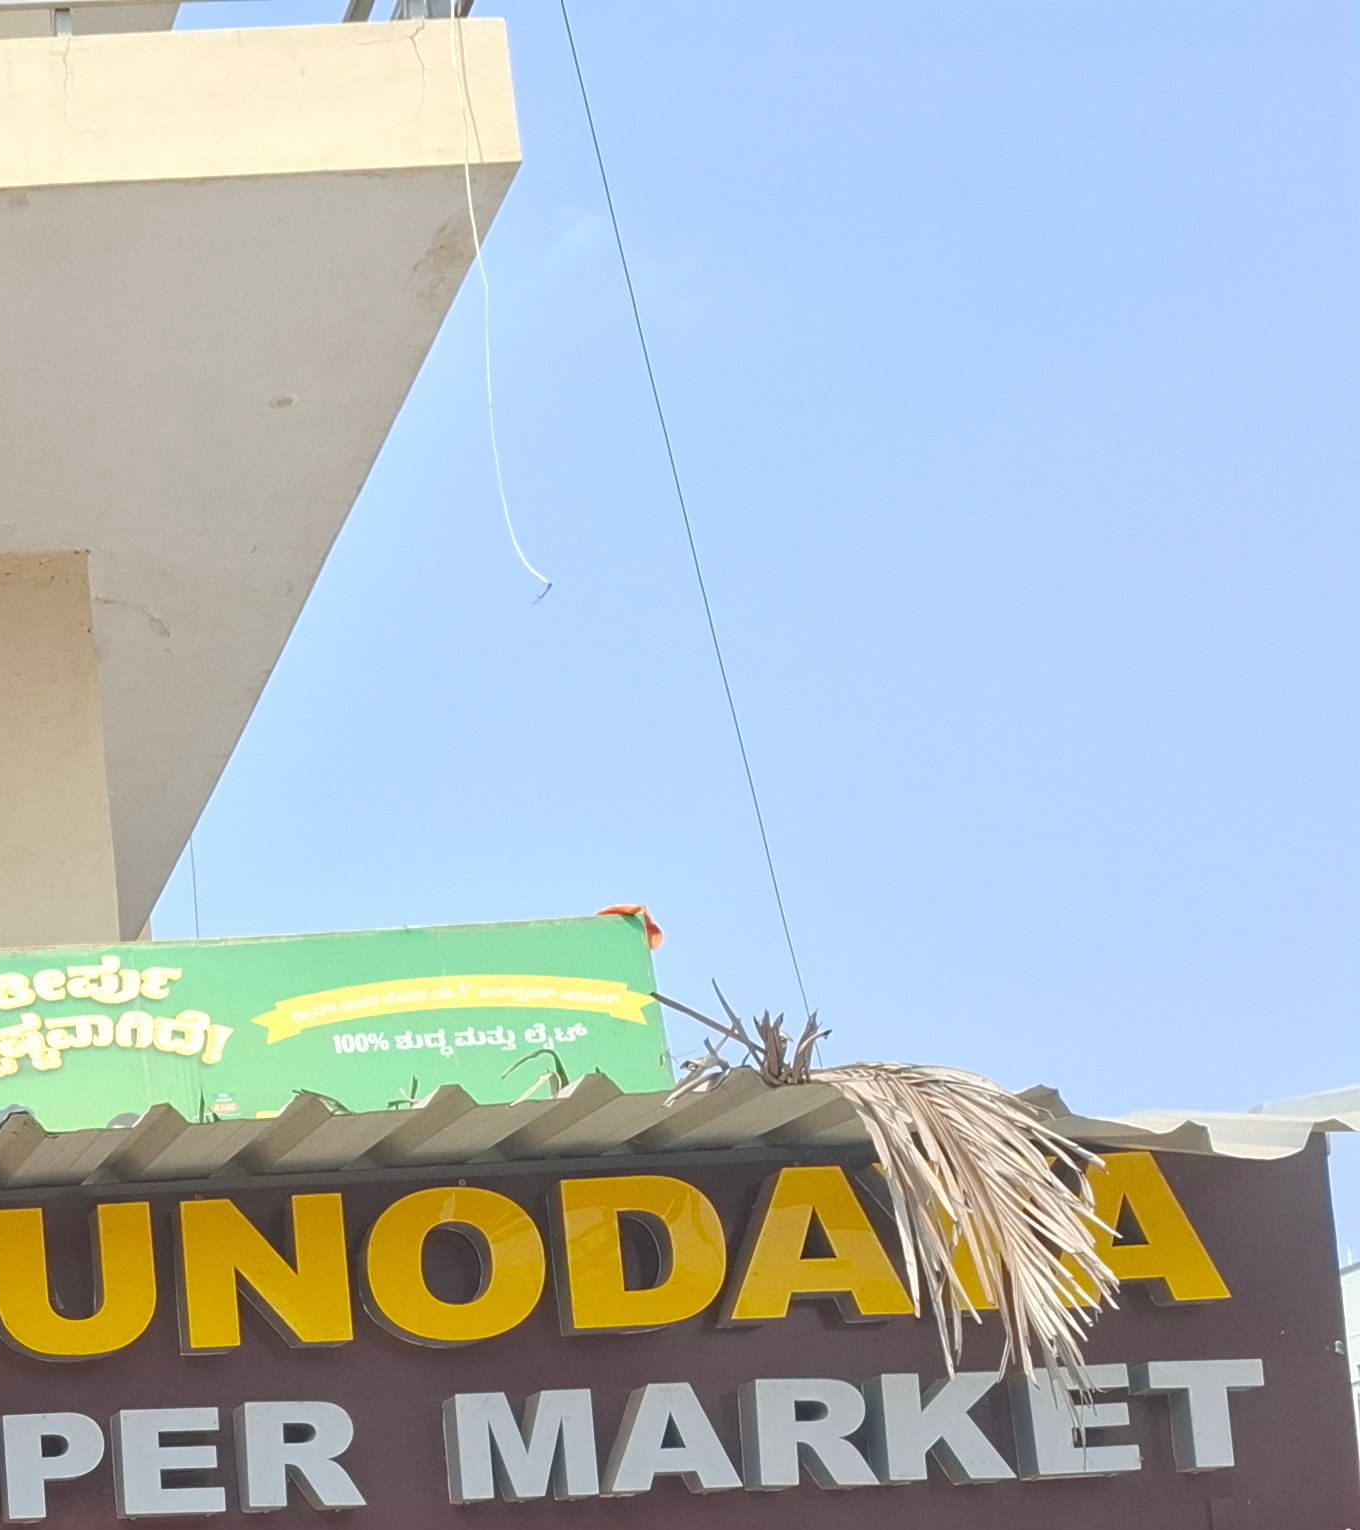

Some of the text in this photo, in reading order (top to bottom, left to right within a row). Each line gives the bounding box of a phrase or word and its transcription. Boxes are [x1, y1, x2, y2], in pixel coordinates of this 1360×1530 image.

[332, 1021, 588, 1058] 100% ಶುದ್ಧ ಮತ್ತು ಲೈಟ್
[444, 1358, 1265, 1505] MARKET
